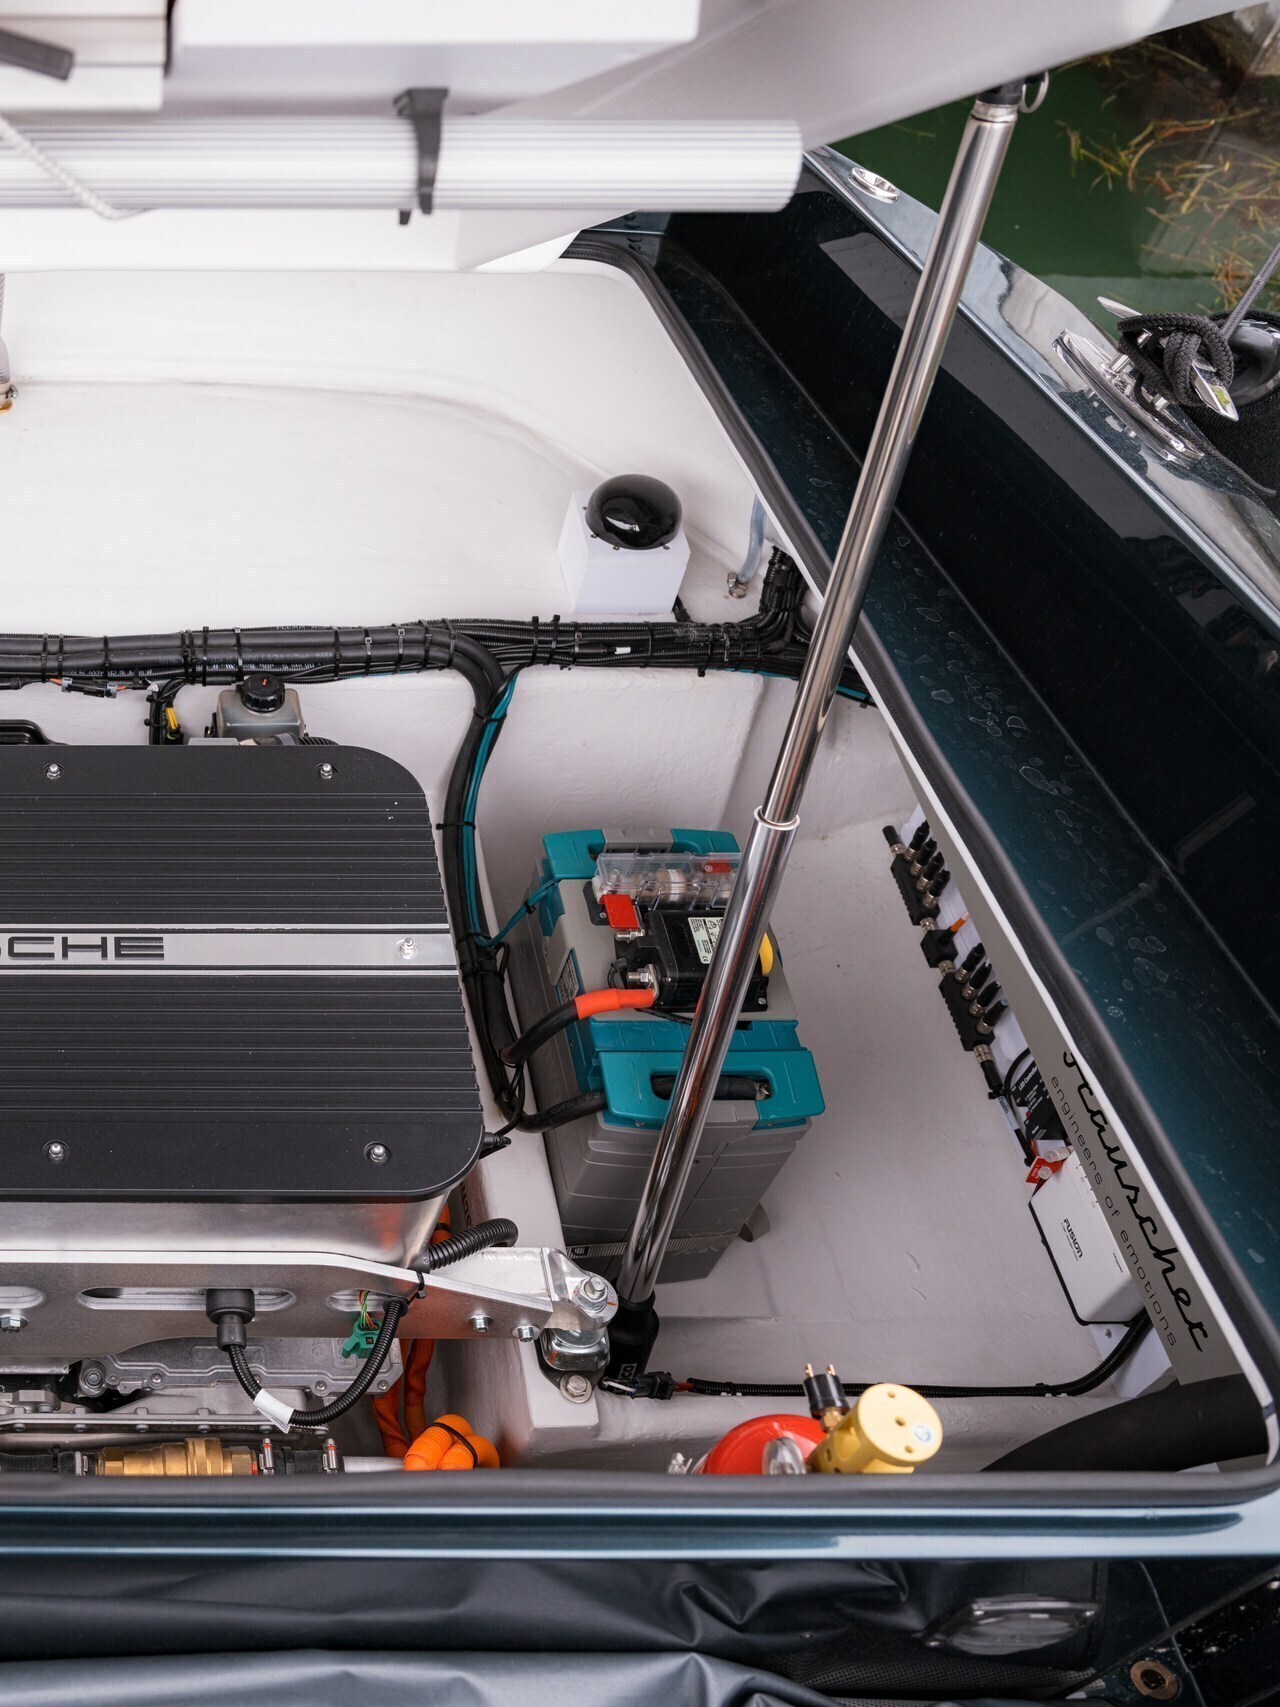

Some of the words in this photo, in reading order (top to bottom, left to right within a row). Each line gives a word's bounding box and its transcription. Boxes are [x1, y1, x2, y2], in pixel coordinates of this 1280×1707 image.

[1051, 1076, 1103, 1185] engineers
[1105, 1195, 1121, 1217] of
[1120, 1229, 1177, 1347] emotions
[1063, 1217, 1083, 1259] FUSION
